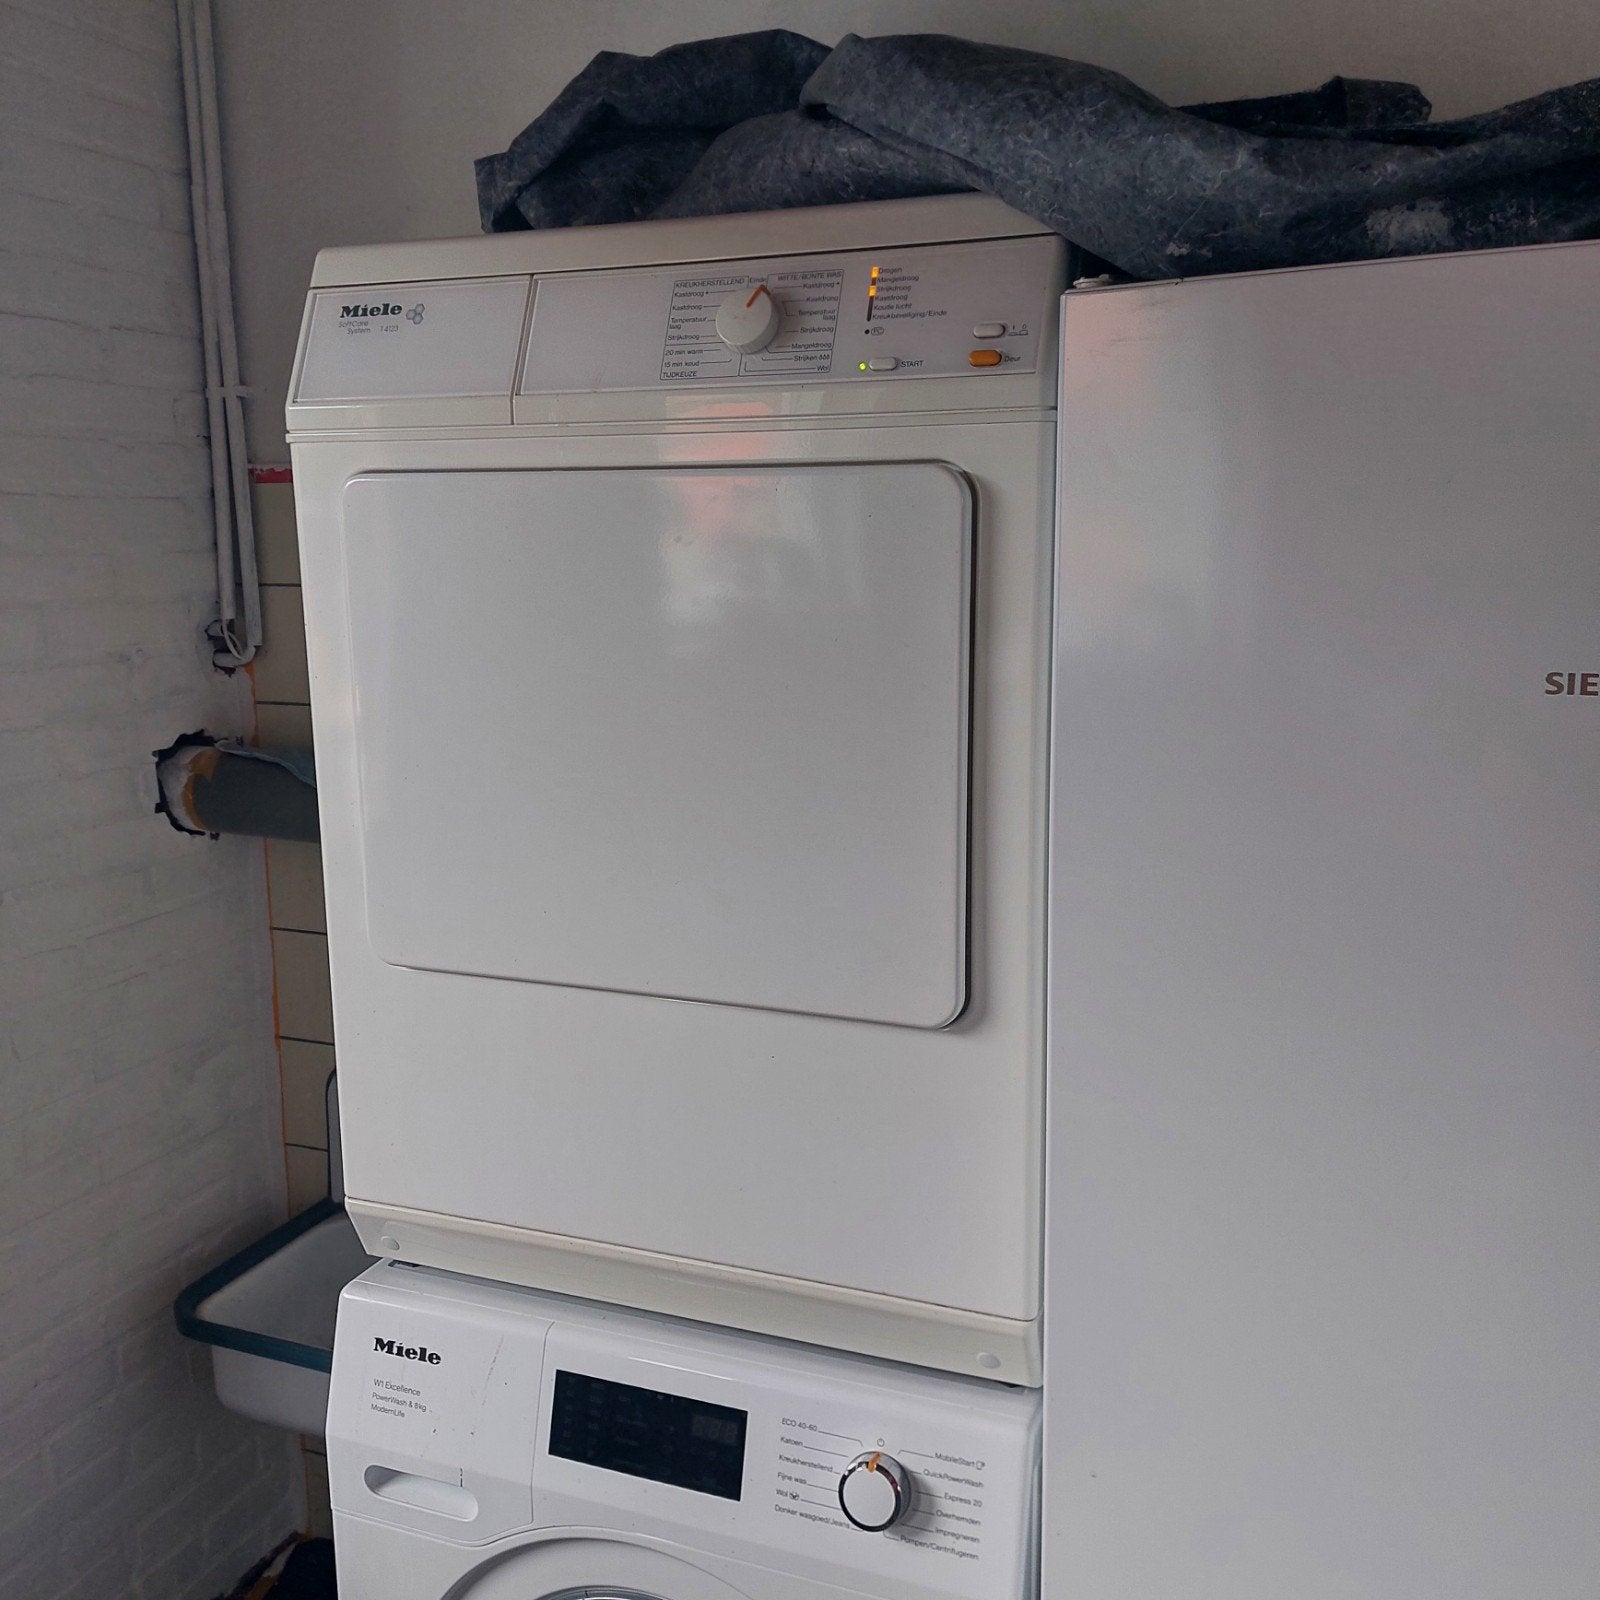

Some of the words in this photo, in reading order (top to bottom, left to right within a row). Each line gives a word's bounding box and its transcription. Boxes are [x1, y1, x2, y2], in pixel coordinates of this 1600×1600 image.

[676, 278, 745, 289] KREUKHERSTELLEND
[674, 290, 705, 298] Kastdroog
[340, 303, 403, 318] Miele
[672, 304, 703, 312] Kastdroog
[671, 317, 707, 325] Temperatuur
[667, 333, 700, 342] Strijkdroog
[792, 342, 833, 351] Mangeldroog
[794, 355, 818, 363] Strijken
[663, 371, 698, 379] TIJDKEUZE
[1545, 672, 1600, 696] SIE
[374, 1337, 442, 1365] Miele
[374, 1379, 384, 1388] W1
[385, 1382, 421, 1396] Excellence
[372, 1392, 408, 1407] PowerWash
[371, 1404, 406, 1418] ModernLife
[782, 1417, 797, 1428] ECO
[798, 1422, 818, 1432] 40-60
[780, 1436, 804, 1447] Katoen
[778, 1454, 833, 1473] Kreukherstellend
[935, 1452, 976, 1468] MobileStart
[777, 1472, 793, 1483] Fijne
[794, 1476, 807, 1485] was
[923, 1469, 984, 1489] QuickPowerWash
[776, 1489, 789, 1498] Wol
[944, 1493, 973, 1507] Express
[973, 1500, 983, 1508] 20
[774, 1504, 798, 1517] Donker
[936, 1509, 982, 1526] Overhemden
[935, 1527, 981, 1544] Impregneren
[900, 1535, 980, 1561] Pompen/Centrifugeren
